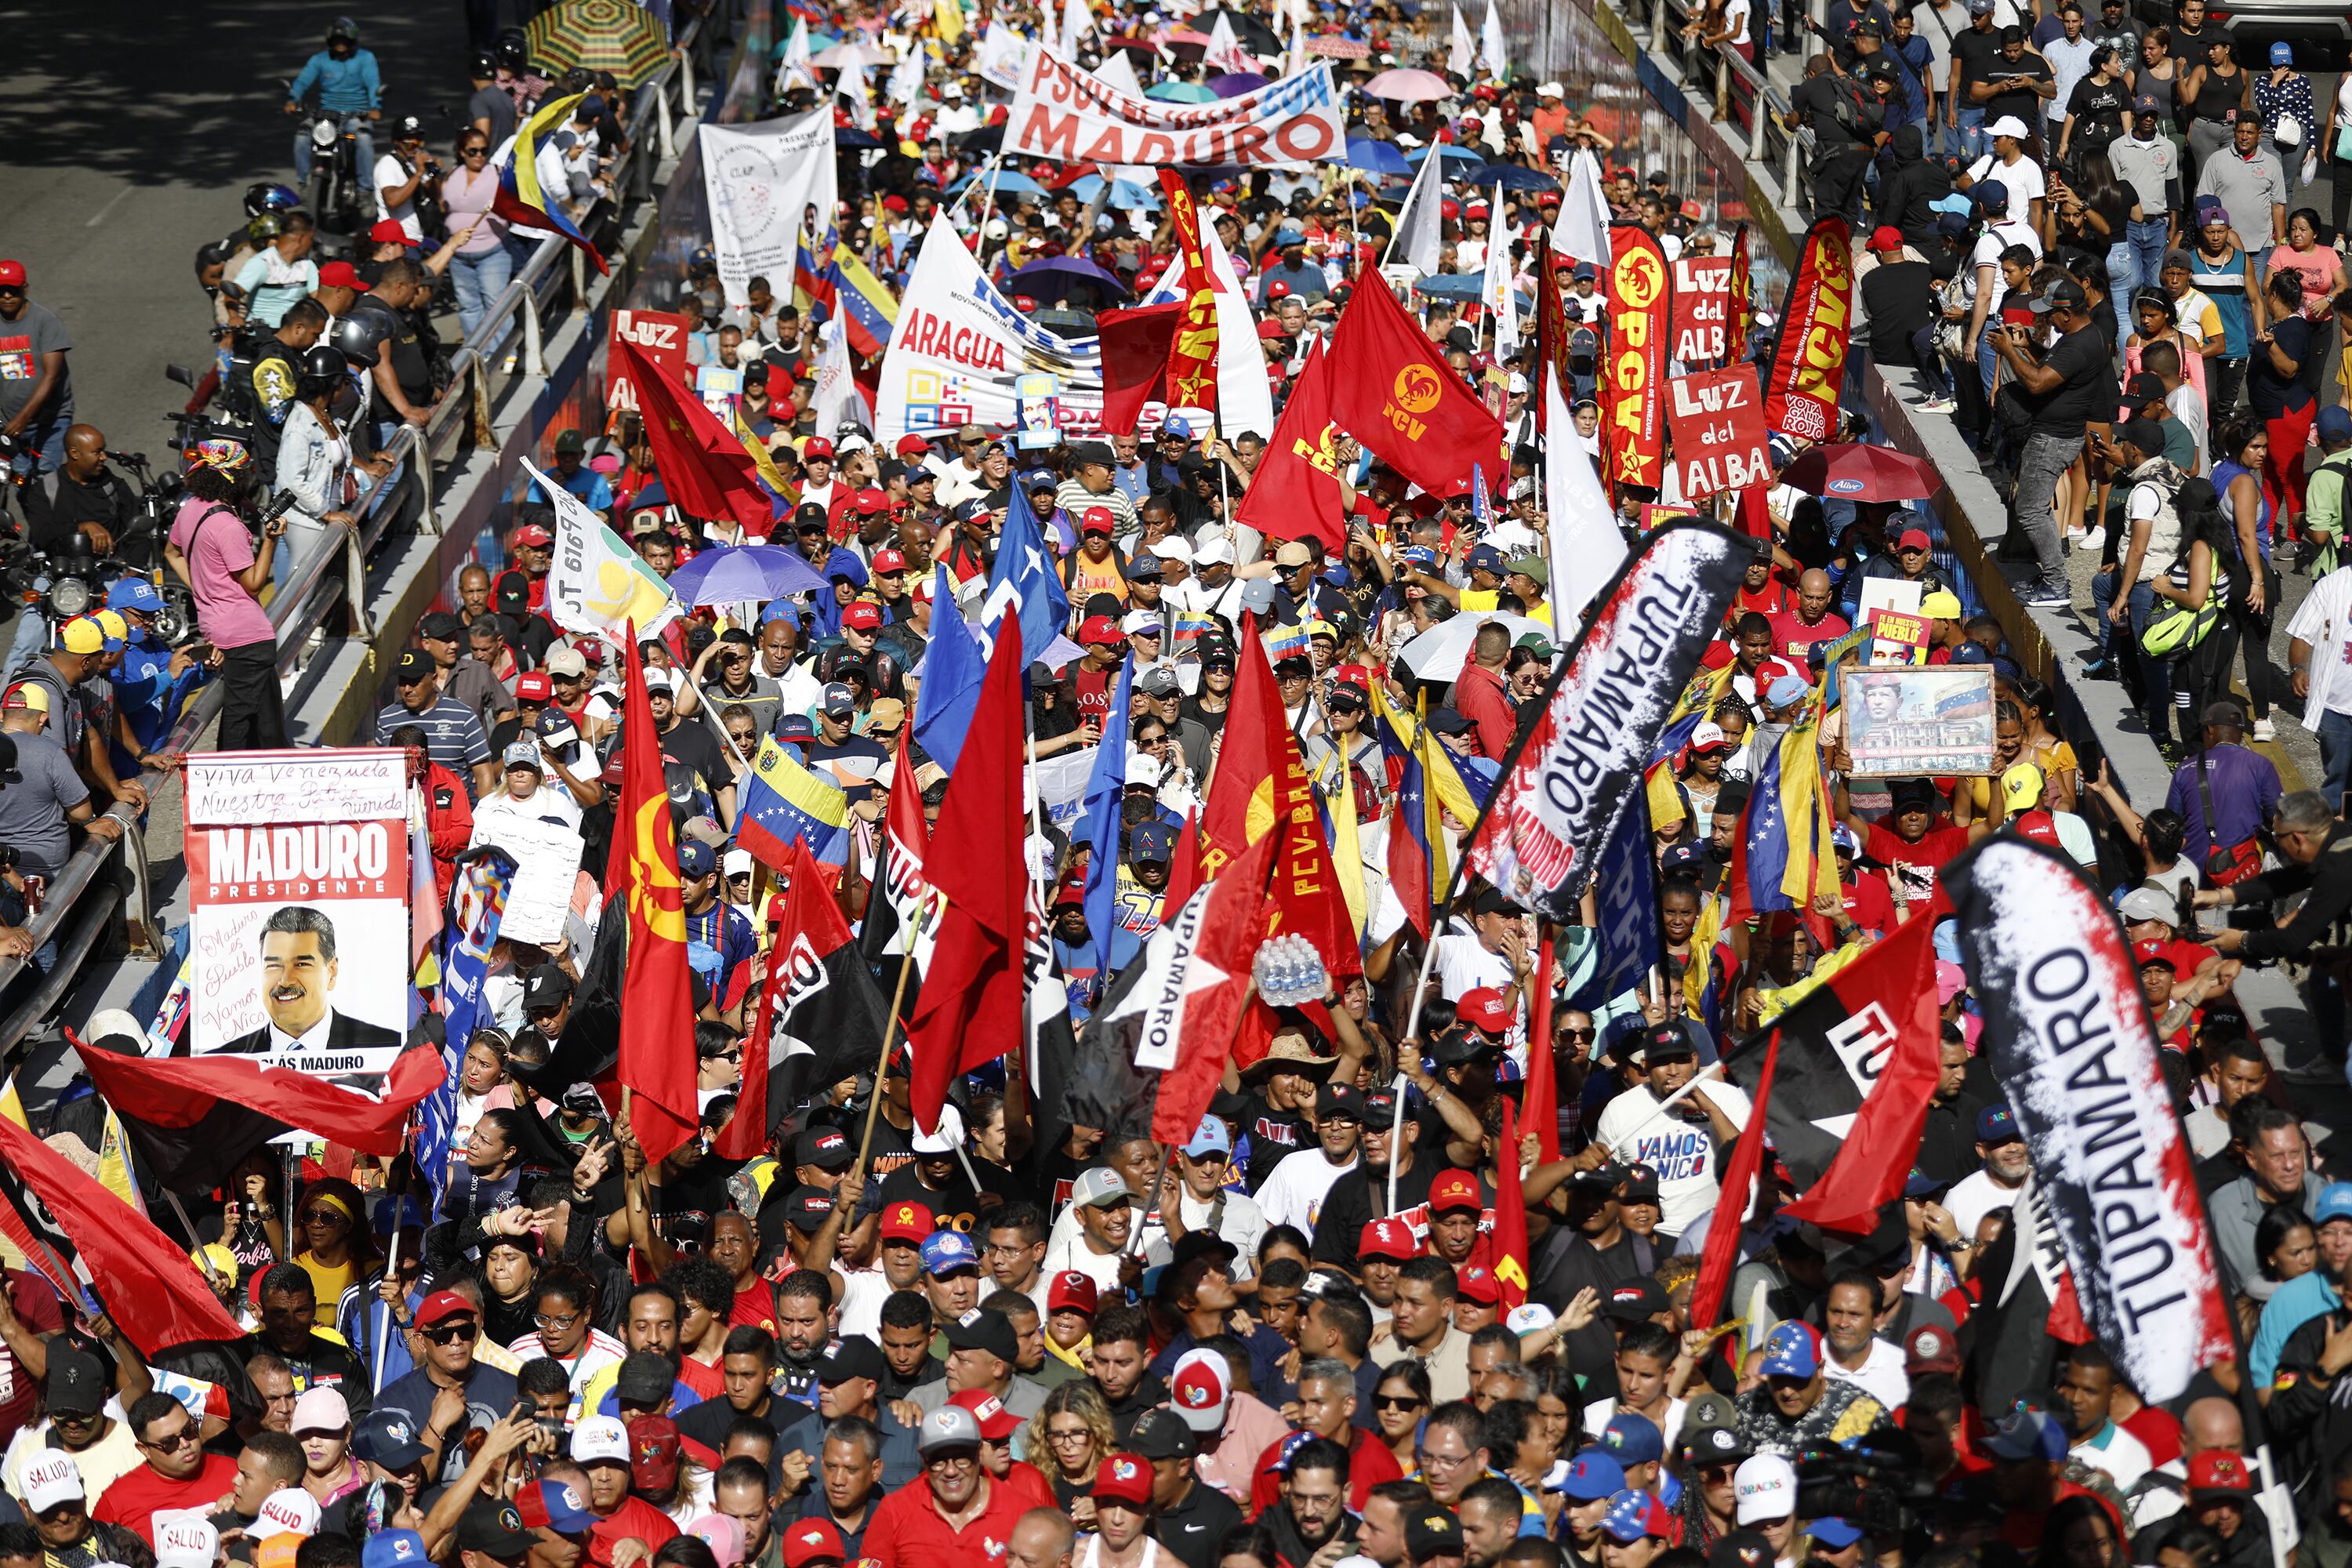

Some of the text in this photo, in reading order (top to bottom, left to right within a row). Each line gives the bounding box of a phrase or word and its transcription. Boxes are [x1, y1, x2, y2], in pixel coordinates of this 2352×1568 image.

[1260, 66, 1329, 117] CON
[1019, 103, 1333, 166] MADURO
[1675, 260, 1730, 293] Luz
[1693, 299, 1725, 321] del
[615, 310, 678, 350] Luz
[899, 307, 1004, 372] ARAGUA
[1677, 325, 1725, 361] ALB
[1792, 325, 1810, 366] COMUNISTA
[1805, 315, 1812, 328] DE
[1798, 285, 1847, 405] PCV
[1616, 310, 1648, 435] PCV
[1648, 388, 1655, 398] DE
[1672, 378, 1748, 418] Luz
[1785, 394, 1822, 416] VOTA
[1645, 399, 1655, 442] VENEZUELA
[1700, 419, 1735, 445] del
[1782, 415, 1825, 440] ROJO
[1788, 407, 1825, 428] GALLO
[1686, 447, 1771, 497] ALBA
[1835, 480, 1860, 492] Alive
[1876, 623, 1918, 644] PUEBLO
[1886, 615, 1895, 624] EN
[1544, 571, 1693, 816] TUPAMARO
[195, 760, 390, 787] Viva Venezuela
[195, 780, 365, 818] Nuestra Patria
[209, 822, 388, 884] MADURO
[209, 880, 385, 899] PRESIDENTE
[199, 909, 258, 958] Maduro
[229, 937, 243, 955] es
[205, 951, 255, 998] Pueblo
[1149, 885, 1210, 1047] TUPAMARO
[201, 987, 258, 1032] Vamos
[223, 1011, 265, 1042] Nico
[301, 1055, 364, 1070] MADURO
[1638, 1130, 1709, 1163] VAMOS
[2027, 946, 2187, 1334] TUPAMARO
[1656, 1153, 1706, 1180] NICO
[30, 1461, 68, 1490] SALUD
[1740, 1479, 1781, 1495] CARACAS
[263, 1501, 301, 1529] SALUD
[167, 1529, 205, 1550] SALUD
